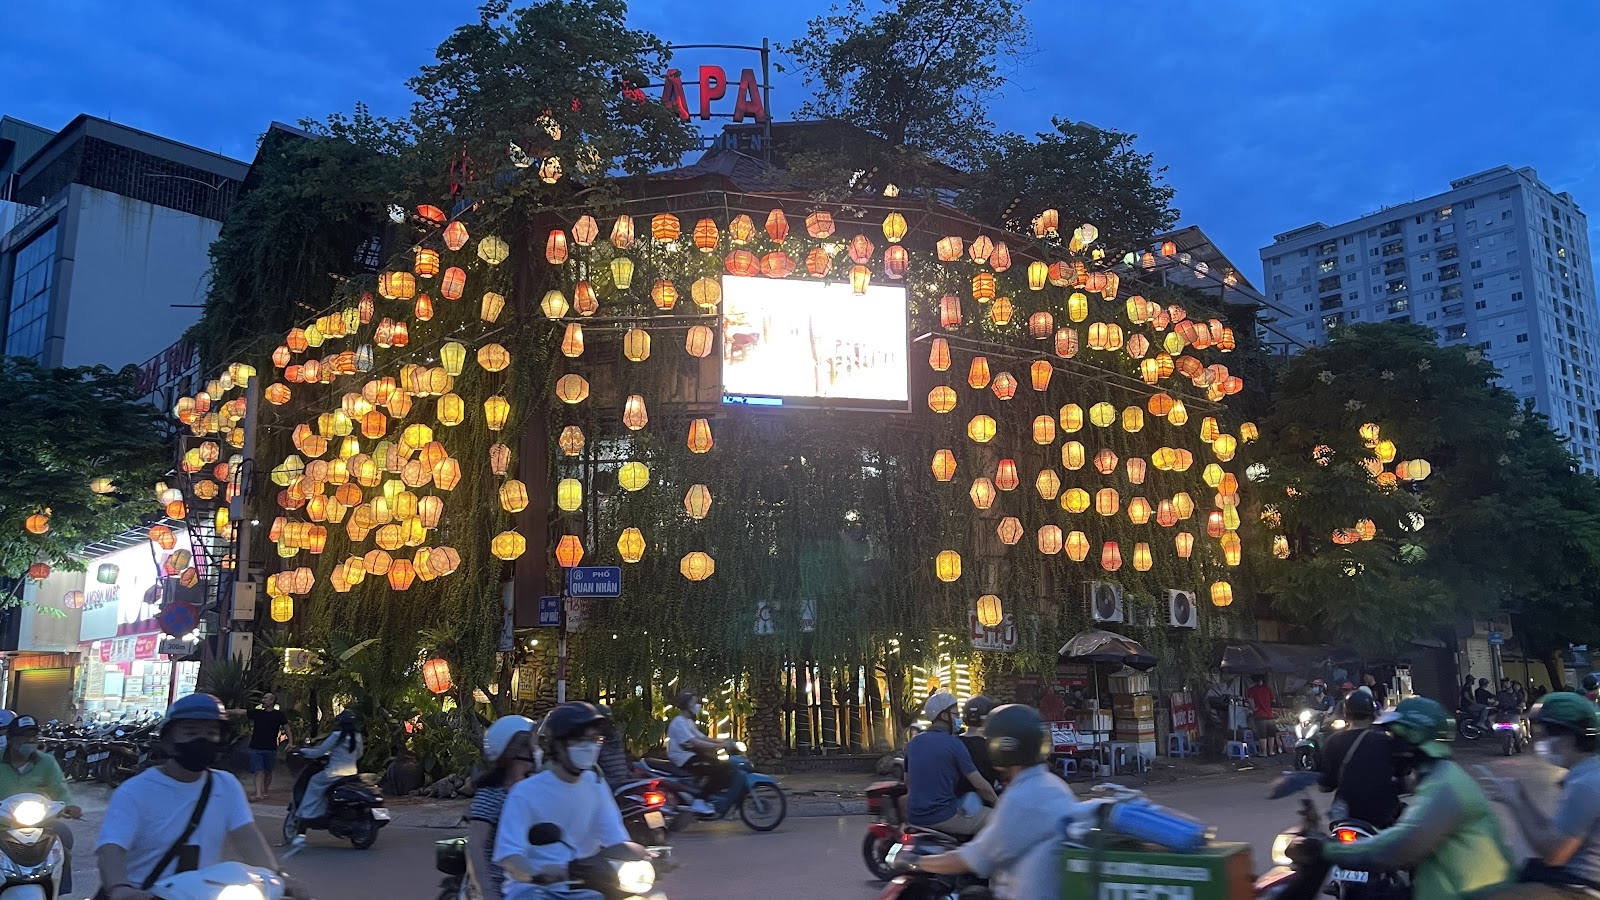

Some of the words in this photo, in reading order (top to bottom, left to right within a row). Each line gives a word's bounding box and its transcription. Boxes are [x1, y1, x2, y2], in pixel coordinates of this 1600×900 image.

[592, 569, 611, 578] PHỐ
[572, 582, 594, 594] QUAN
[595, 581, 618, 593] NHÂN
[167, 642, 186, 650] 300m
